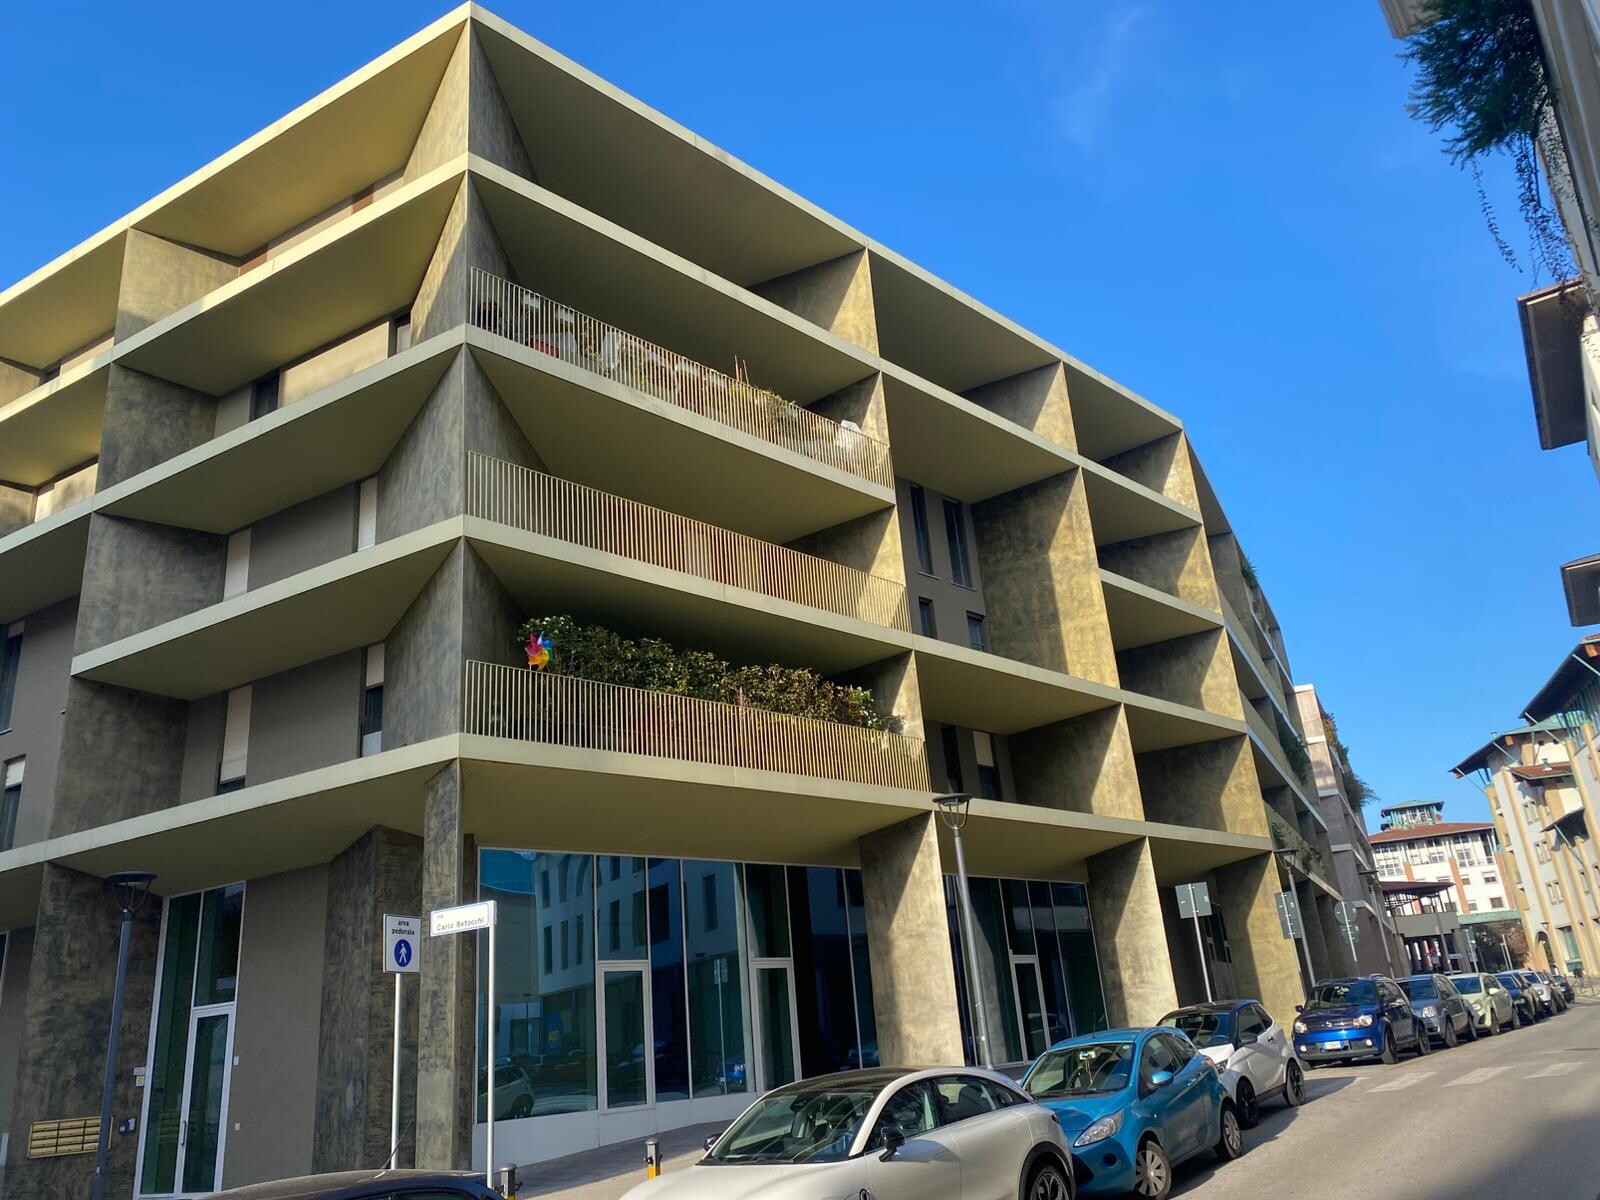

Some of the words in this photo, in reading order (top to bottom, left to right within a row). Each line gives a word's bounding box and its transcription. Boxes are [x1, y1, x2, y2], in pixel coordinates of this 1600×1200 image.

[437, 922, 454, 931] Carlo
[456, 916, 485, 928] Betocchi
[391, 928, 415, 936] pedonale
